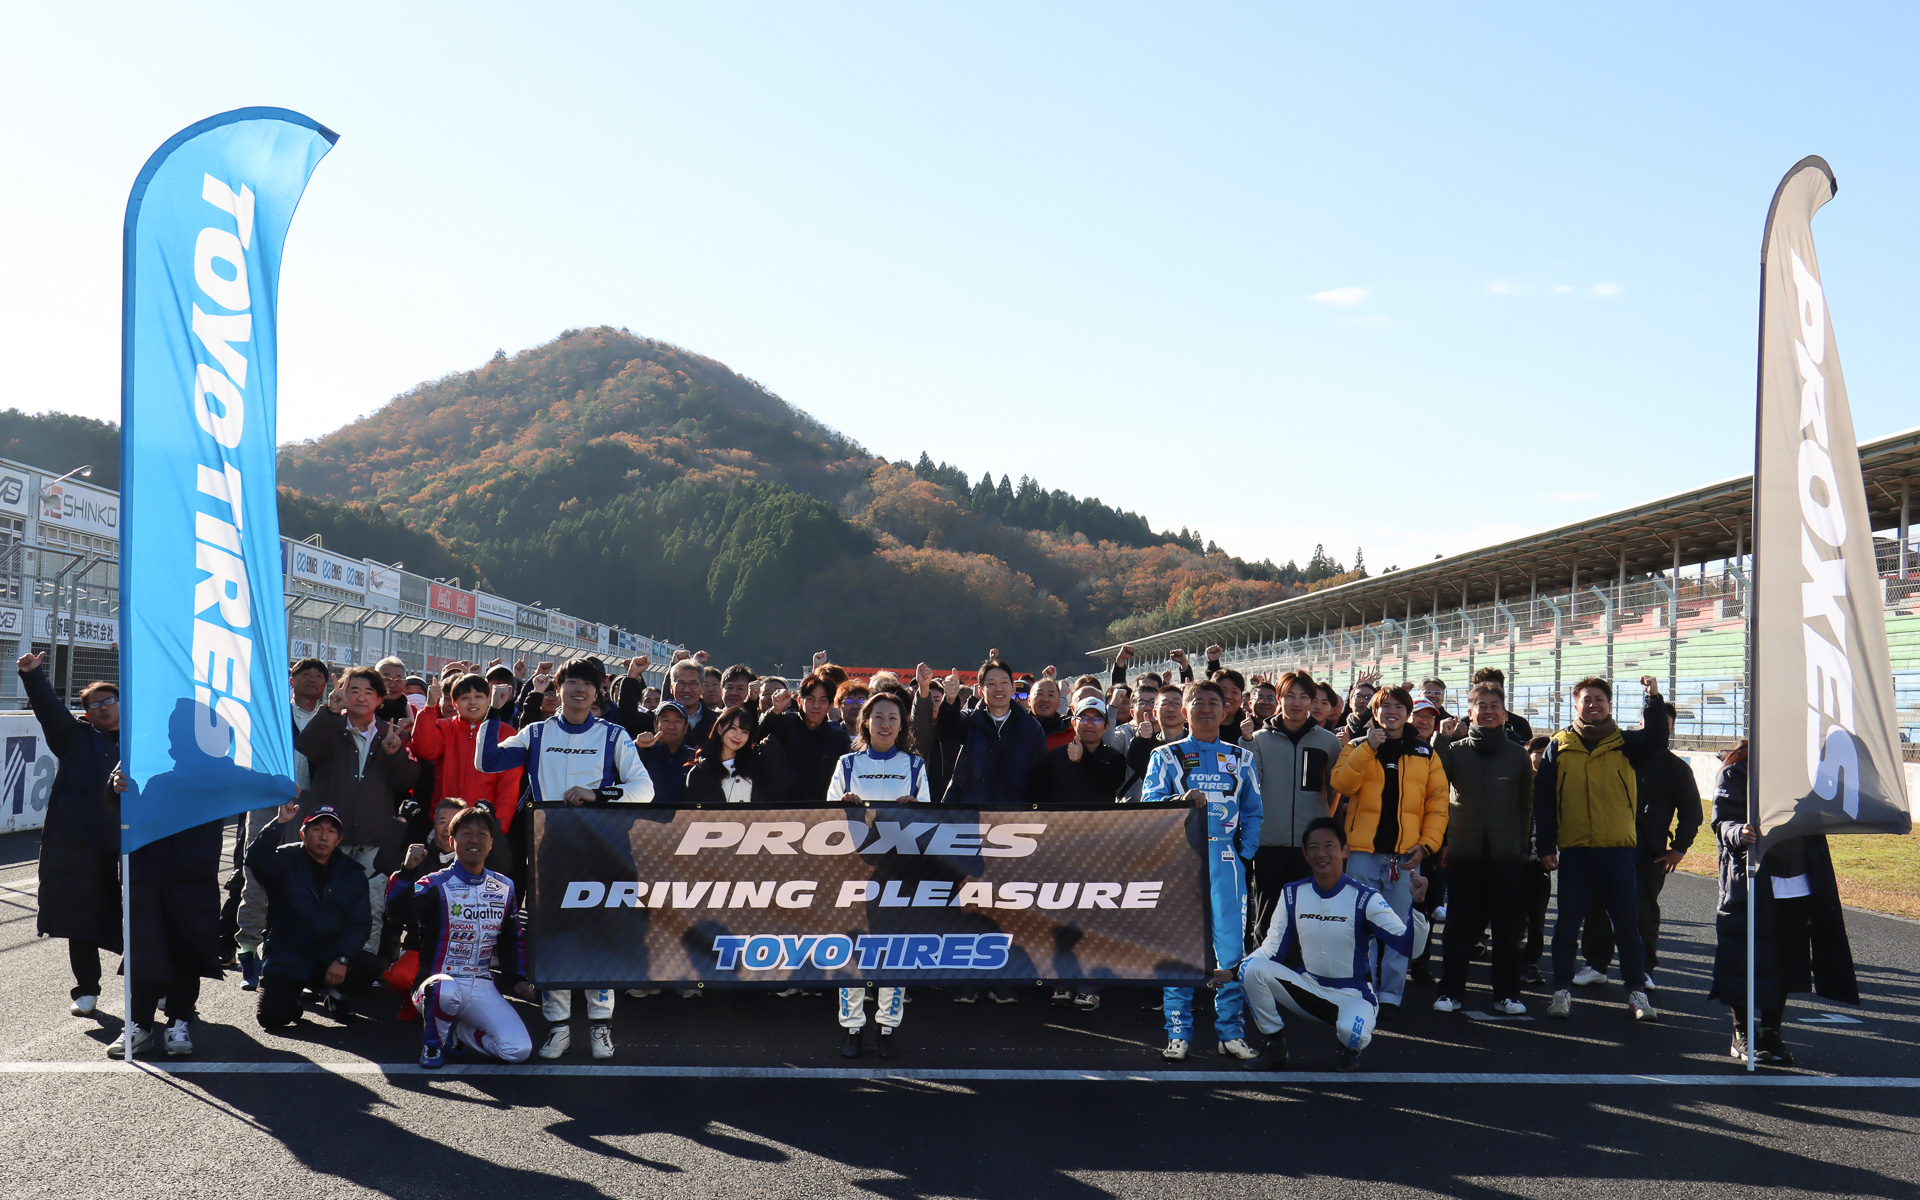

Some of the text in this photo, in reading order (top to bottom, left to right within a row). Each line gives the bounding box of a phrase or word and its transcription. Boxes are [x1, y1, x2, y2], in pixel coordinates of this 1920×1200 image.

[193, 173, 255, 770] TOYO TIRES
[63, 494, 117, 528] SHINKO
[1790, 247, 1860, 820] PROXES
[546, 747, 598, 755] PROXES
[1190, 773, 1221, 782] TOYO
[1197, 782, 1231, 790] TIRES
[675, 822, 1047, 857] PROXES
[561, 881, 1163, 909] DRIVING PLEASURE
[463, 908, 503, 919] Quattro
[1300, 913, 1348, 922] PROXES
